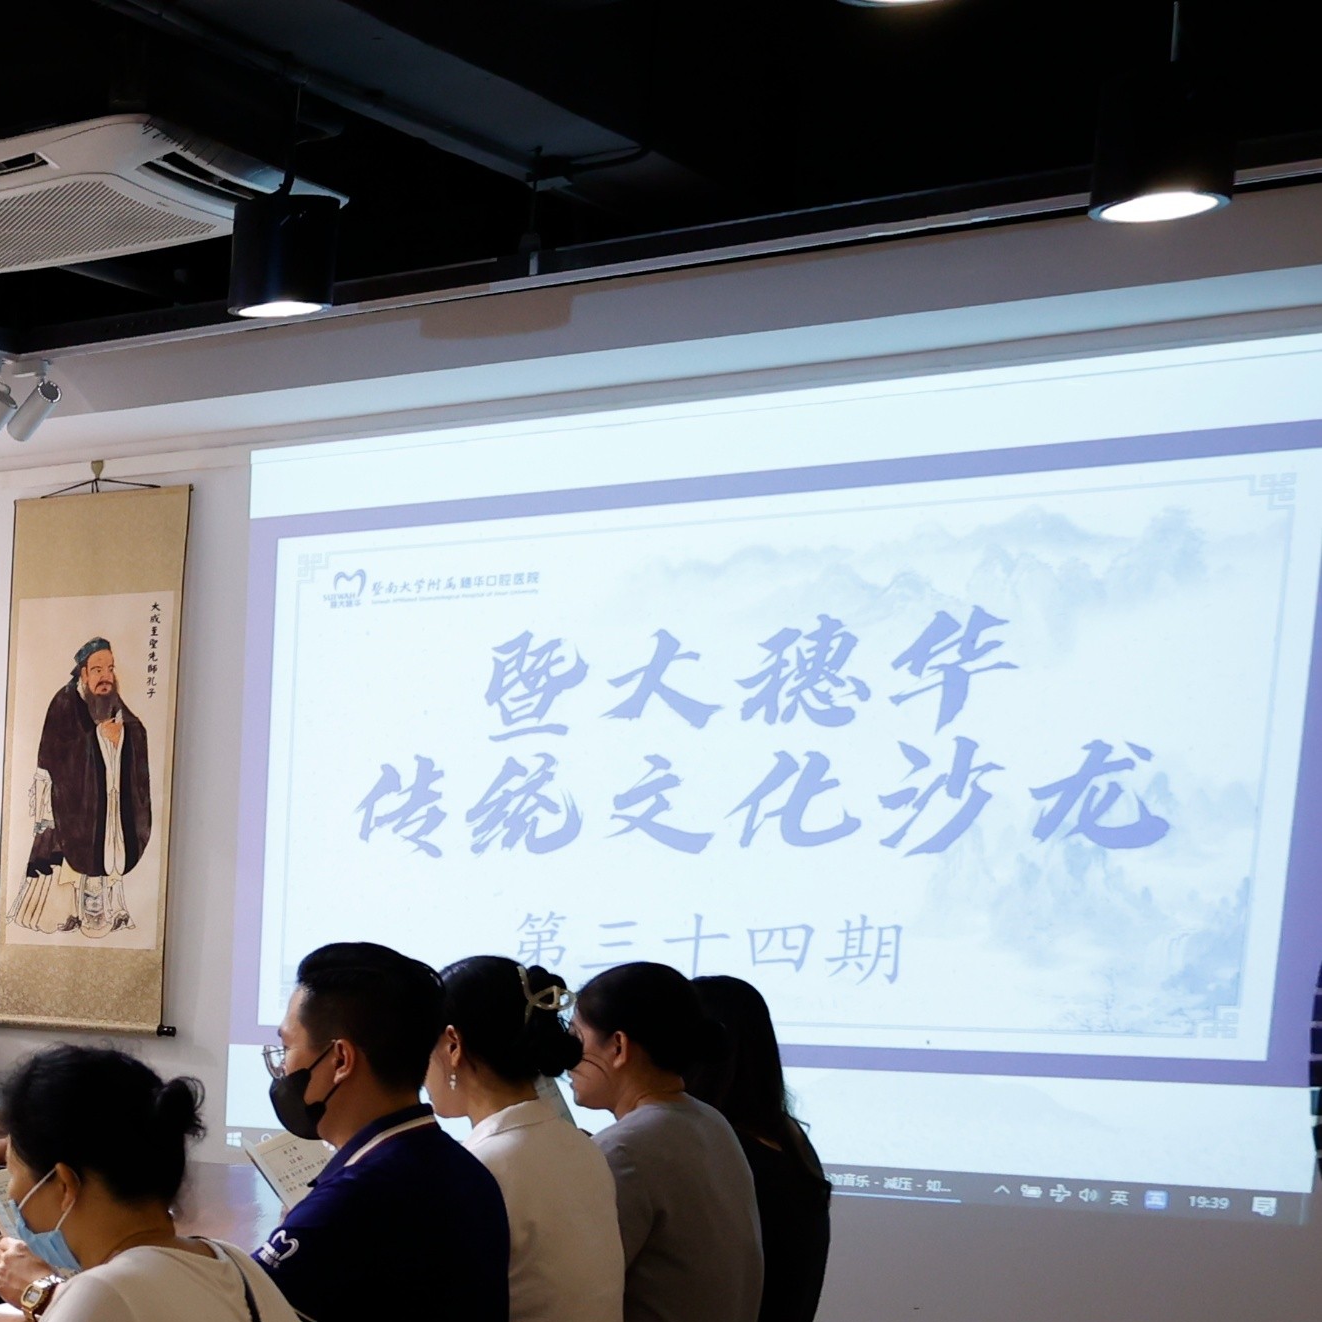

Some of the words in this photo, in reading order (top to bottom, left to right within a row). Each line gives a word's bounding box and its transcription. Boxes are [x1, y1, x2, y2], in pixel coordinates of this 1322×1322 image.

[484, 605, 1020, 744] 暨大穗华
[355, 736, 1171, 860] 传统文化沙龙
[516, 909, 905, 986] 第三十四期
[1110, 1190, 1131, 1206] 英
[1187, 1195, 1231, 1210] 19:39
